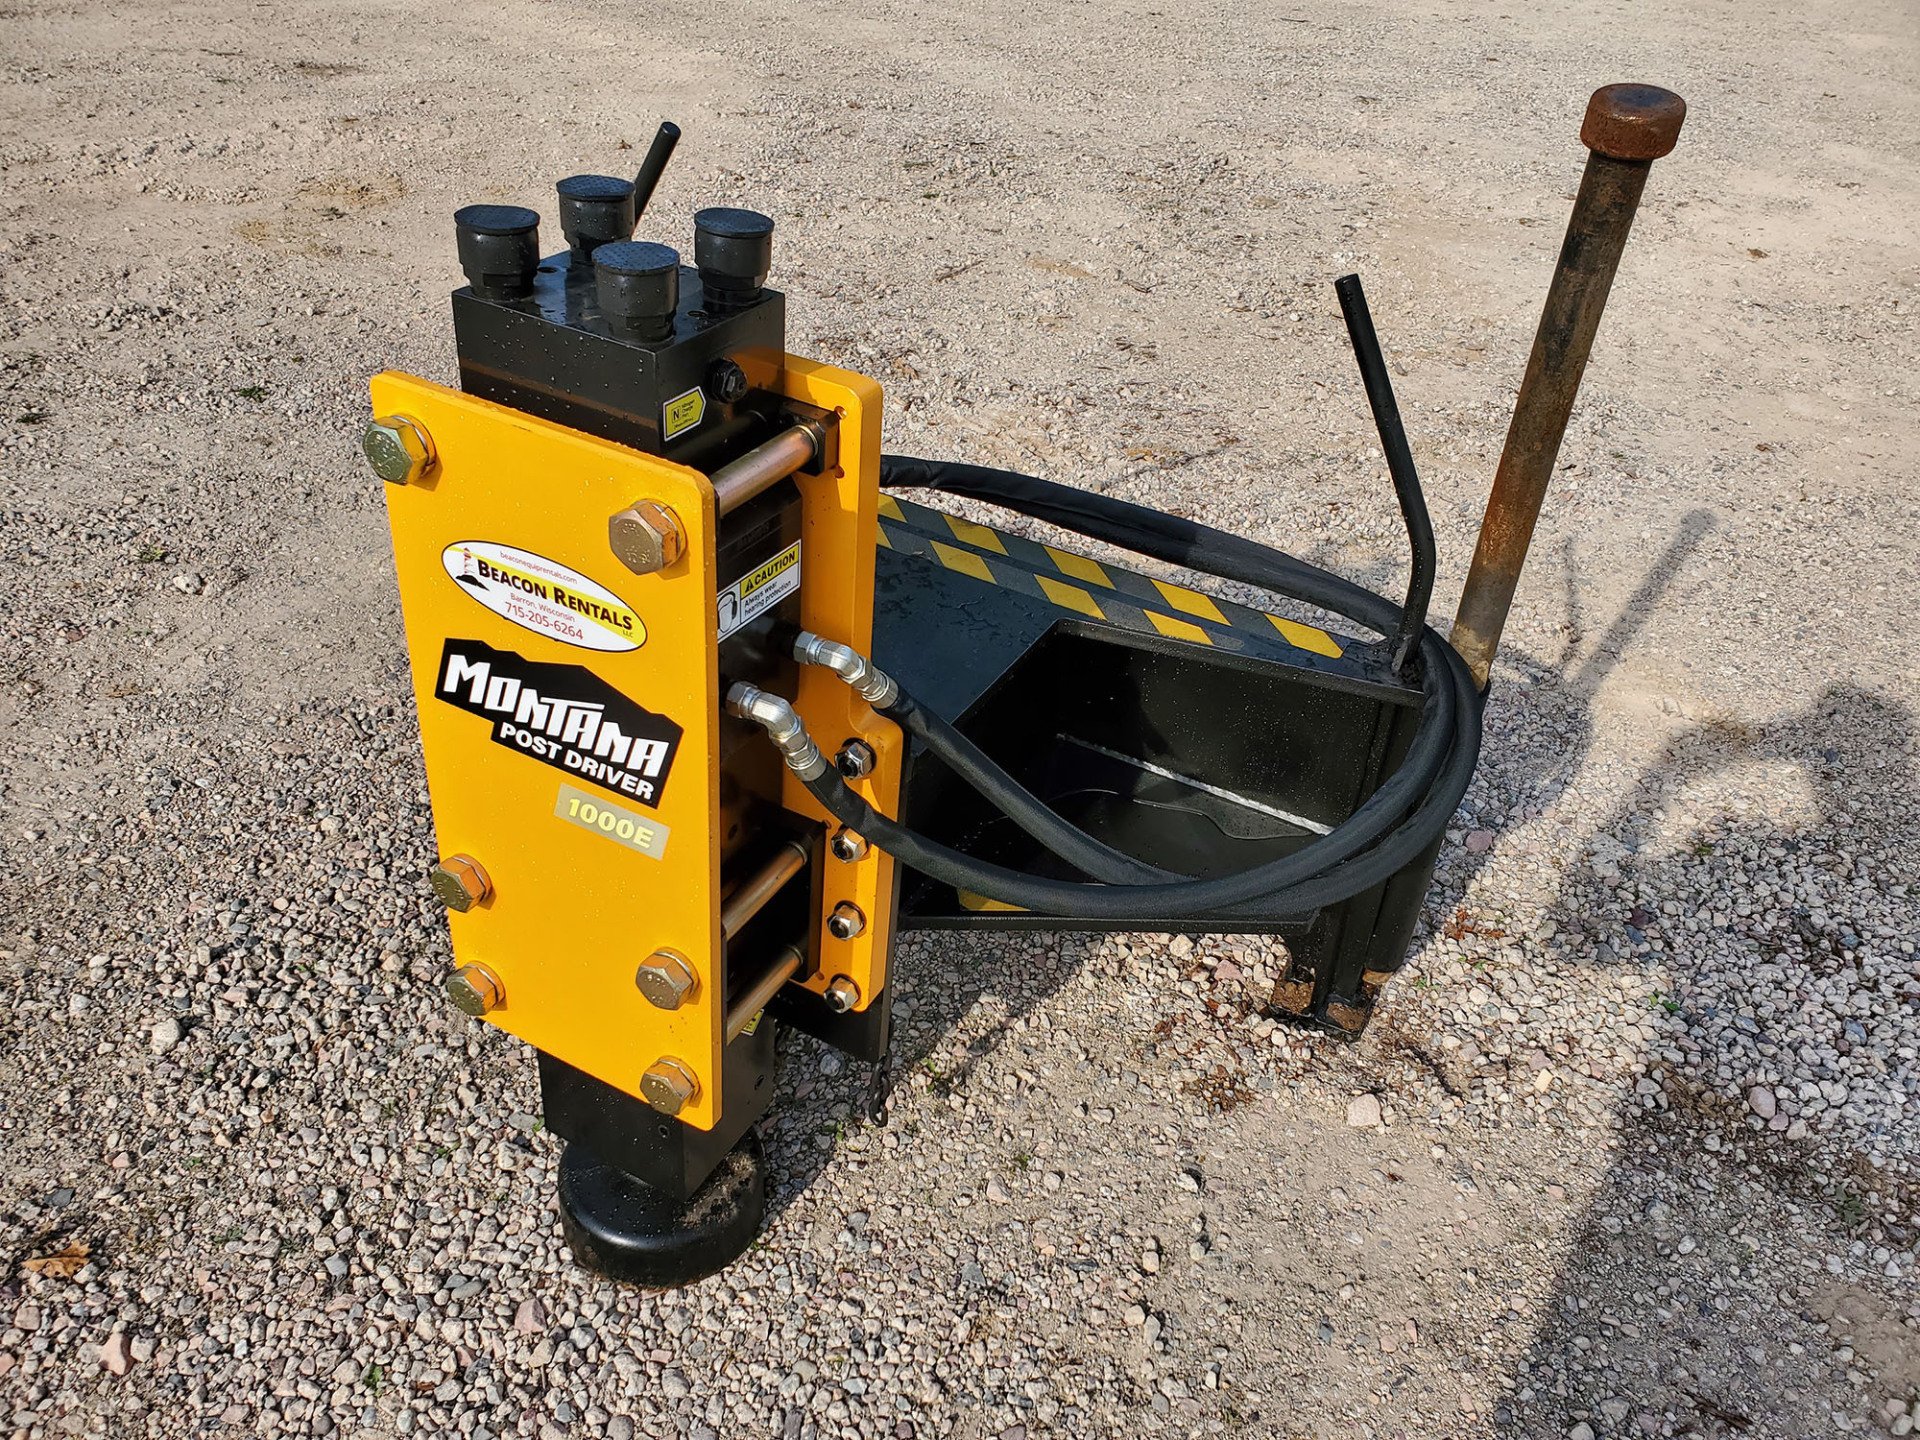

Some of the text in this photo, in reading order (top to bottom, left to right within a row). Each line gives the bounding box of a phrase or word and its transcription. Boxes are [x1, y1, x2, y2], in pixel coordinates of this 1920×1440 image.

[499, 550, 578, 585] beaconequiprentals.com
[754, 551, 795, 585] CAUTION
[477, 559, 633, 631] BEACON RENTALS
[510, 592, 576, 622] Barron, Wisconsin
[505, 601, 584, 640] 715-205-6264
[443, 654, 670, 778] MONTANA
[500, 722, 655, 800] POST DRIVER
[568, 797, 655, 849] 1000E
